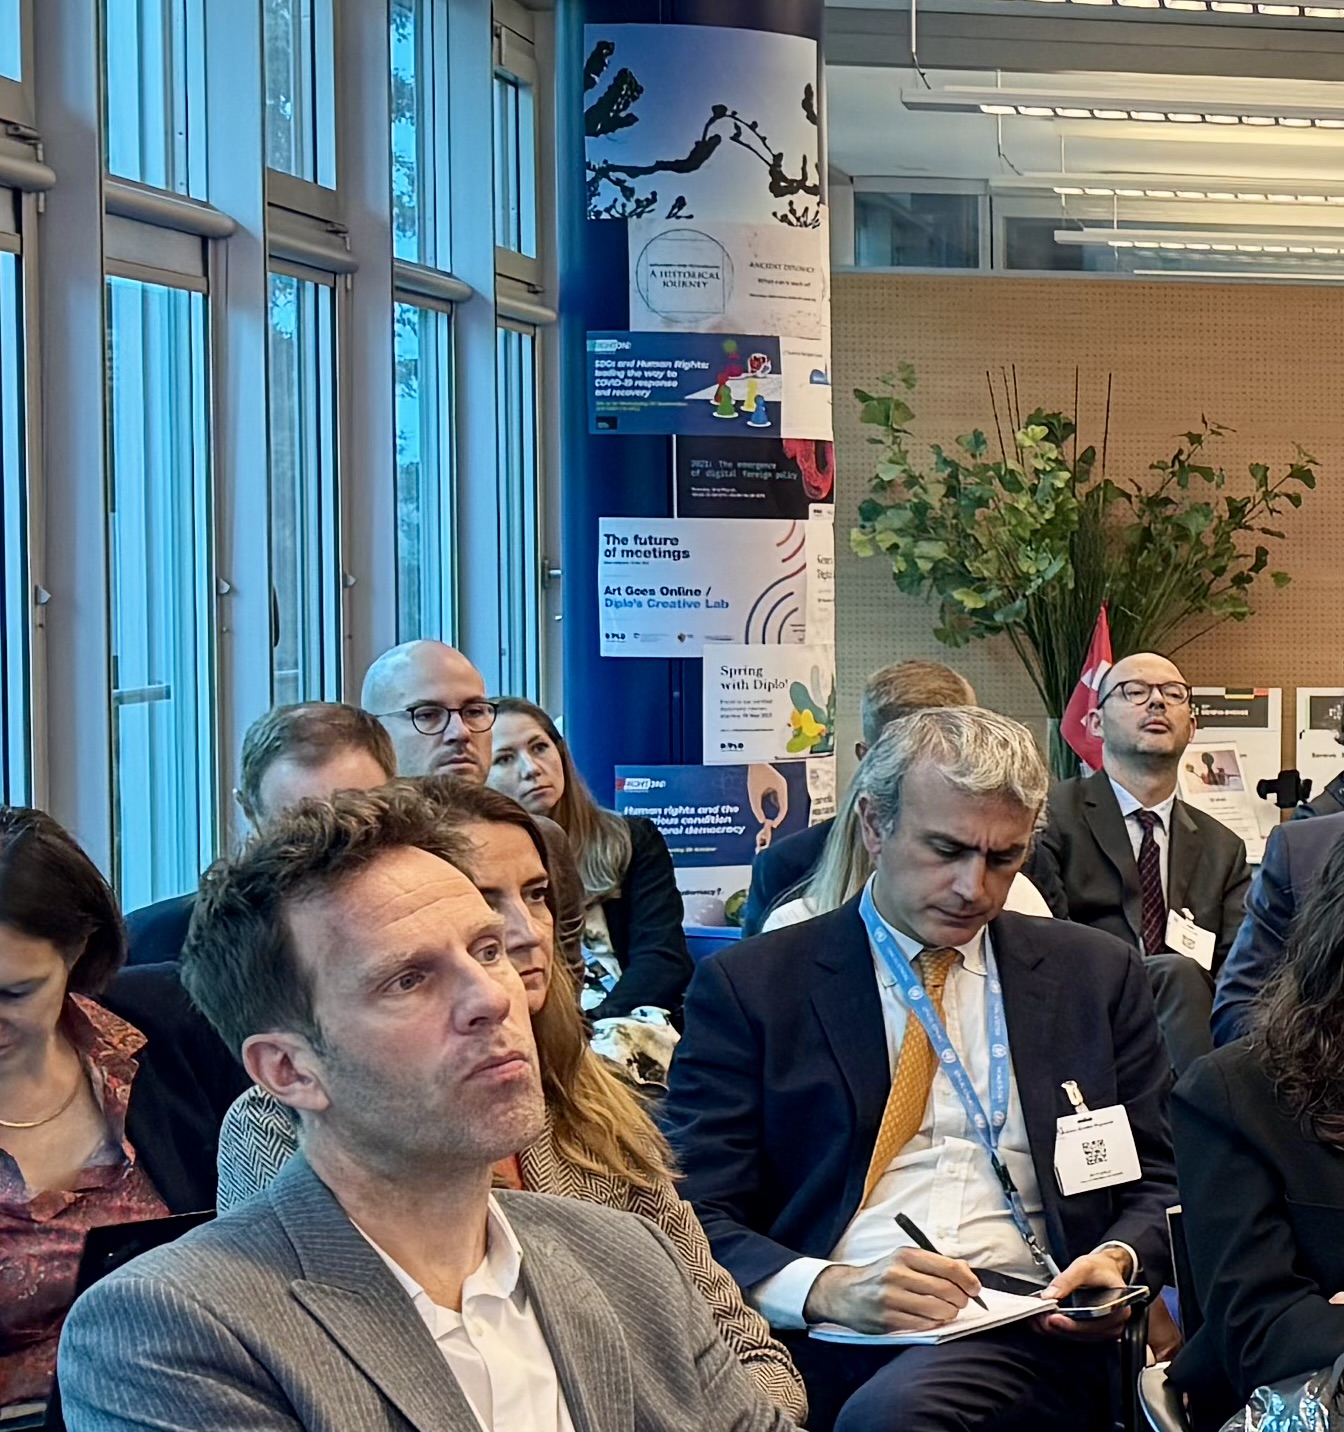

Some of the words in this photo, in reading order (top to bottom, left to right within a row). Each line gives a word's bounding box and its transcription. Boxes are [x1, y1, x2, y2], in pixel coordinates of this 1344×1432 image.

[649, 270, 658, 279] A
[660, 271, 721, 280] HISTORICAL
[662, 281, 709, 289] JOURNEY
[617, 360, 635, 368] and
[636, 360, 672, 368] Human
[674, 360, 710, 370] Rights:
[627, 370, 642, 378] the
[644, 371, 665, 379] way
[667, 370, 678, 378] to
[634, 380, 679, 388] response
[612, 390, 651, 399] recovery
[719, 460, 733, 468] The
[706, 470, 736, 478] digital
[742, 471, 772, 480] foreign
[775, 472, 797, 480] policy
[604, 534, 629, 545] The
[633, 534, 679, 546] future
[604, 547, 617, 558] of
[621, 547, 690, 561] meetings
[604, 586, 622, 596] Art
[625, 586, 656, 596] Goes
[660, 586, 701, 596] Online
[604, 598, 643, 609] Diplo's
[647, 599, 701, 609] Creative
[705, 599, 729, 608] Lab
[720, 665, 763, 678] Spring
[720, 679, 749, 690] with
[624, 806, 662, 815] Human
[664, 805, 695, 816] rights
[697, 805, 720, 814] and
[721, 805, 739, 813] the
[681, 814, 732, 824] condition
[685, 826, 746, 835] democracy
